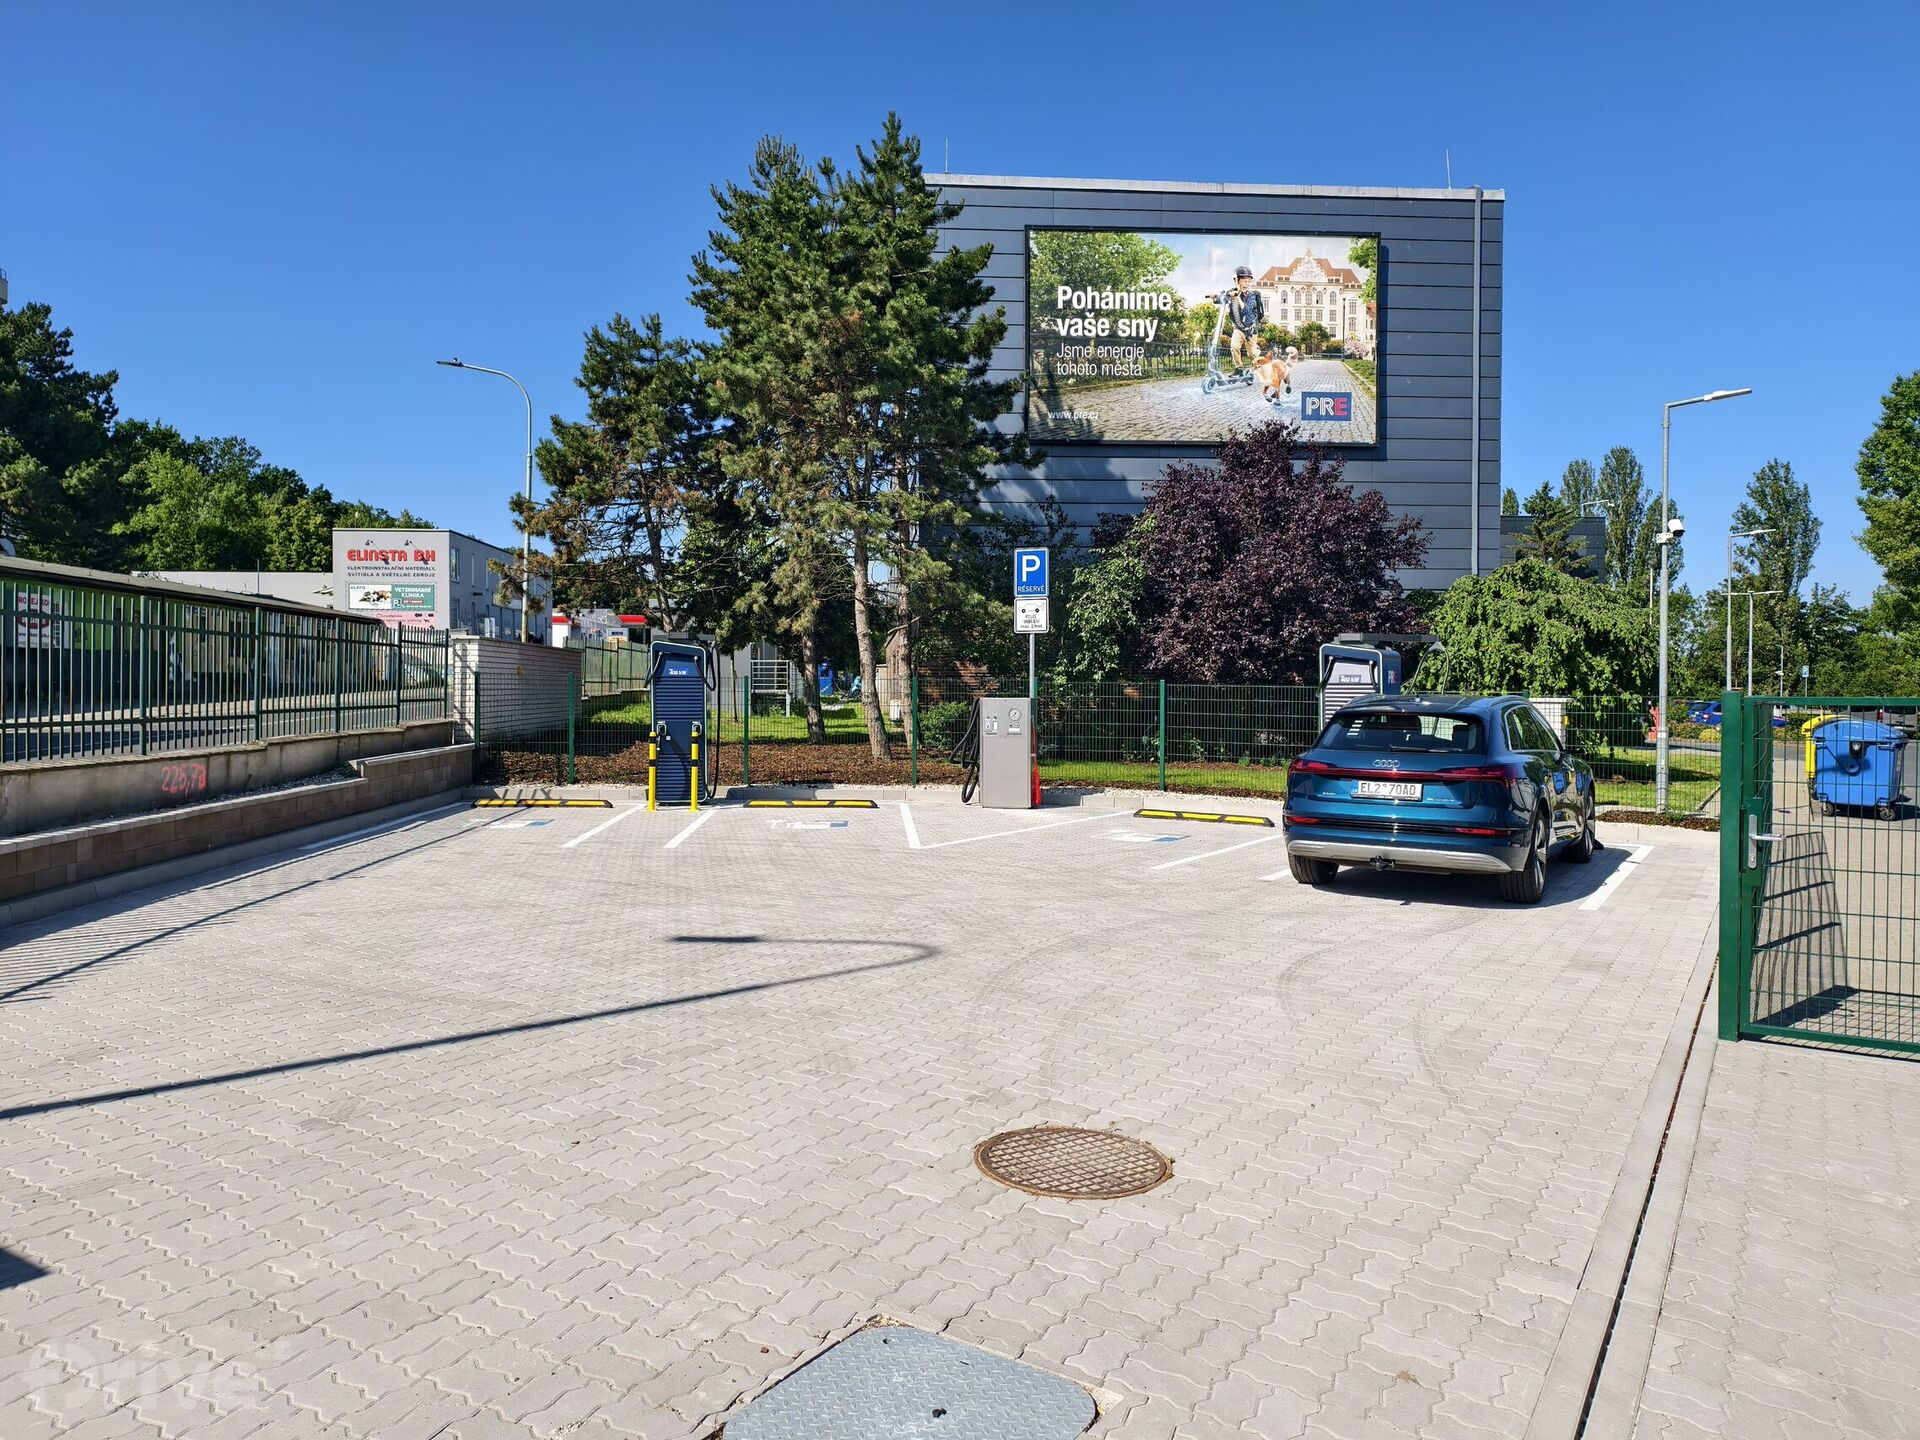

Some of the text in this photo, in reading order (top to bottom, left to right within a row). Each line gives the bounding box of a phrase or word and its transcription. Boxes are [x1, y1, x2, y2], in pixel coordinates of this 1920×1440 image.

[1057, 285, 1172, 310] Poháníme
[1056, 312, 1159, 343] vaše sny
[1056, 342, 1145, 361] Jsme energie
[1056, 360, 1142, 376] tohoto města
[1305, 396, 1348, 416] PRE
[1047, 411, 1099, 421] www.pre.cz
[347, 549, 408, 561] ELINSTA
[1022, 554, 1041, 582] P
[1017, 585, 1045, 593] RÉSERVÉ
[1360, 782, 1381, 794] EL2
